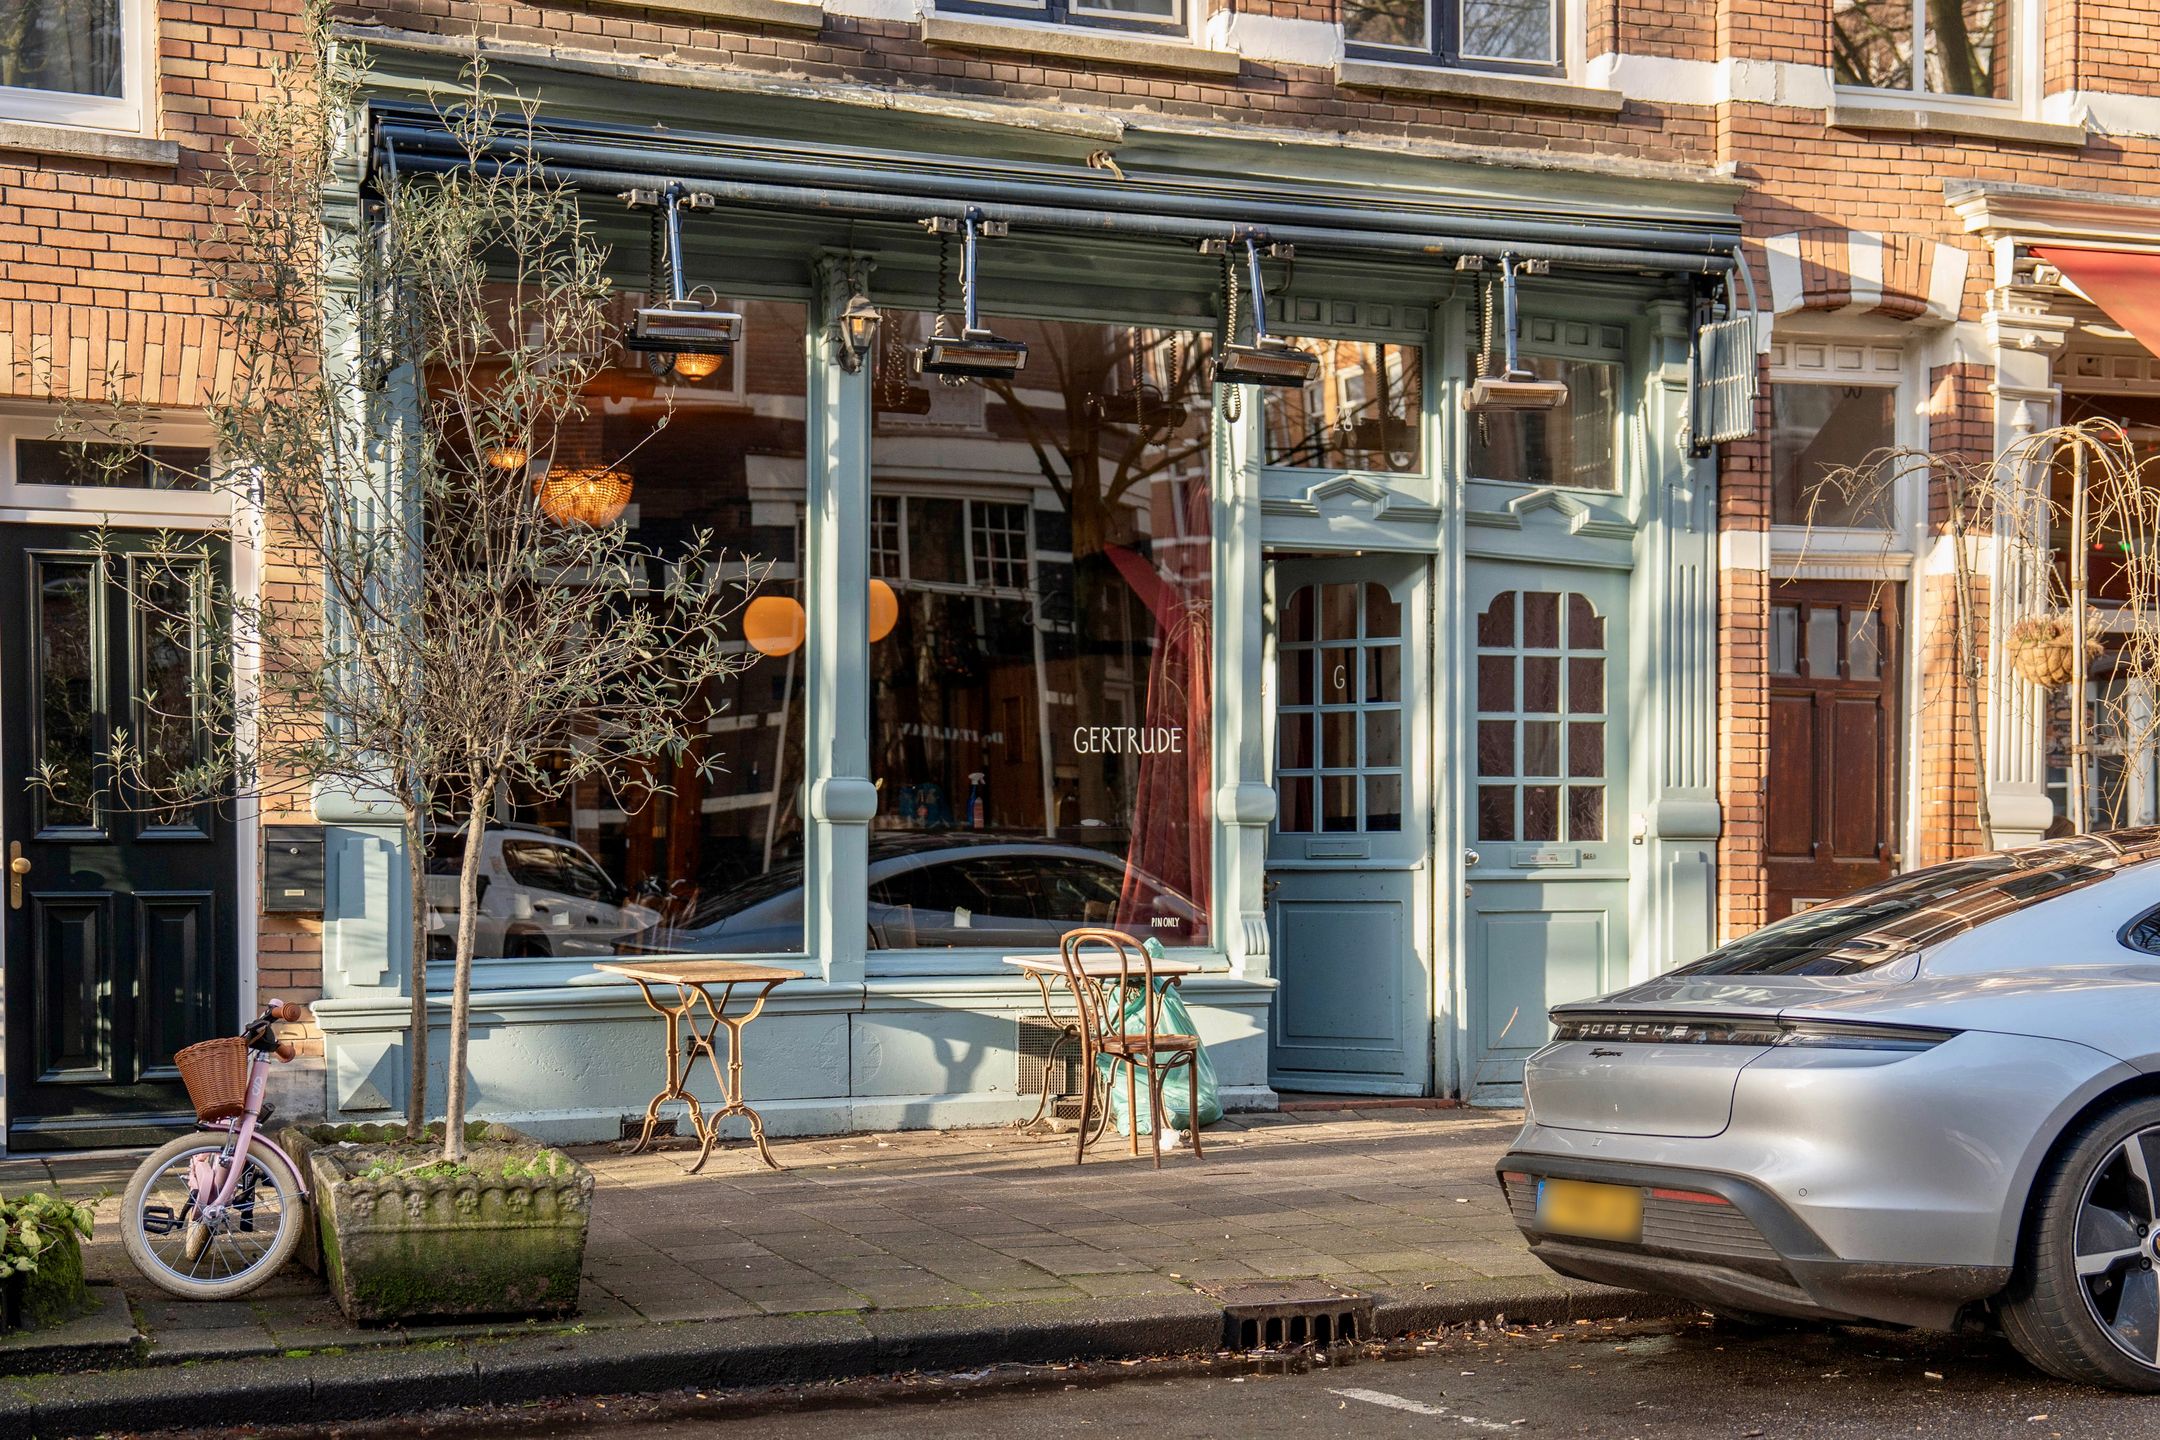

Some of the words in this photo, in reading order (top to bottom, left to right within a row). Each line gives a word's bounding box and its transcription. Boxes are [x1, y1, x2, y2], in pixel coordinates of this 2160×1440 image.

[1333, 405, 1353, 432] 28
[1333, 664, 1345, 690] G
[1073, 726, 1183, 755] GERTRUDE
[1151, 916, 1163, 928] PIN
[1163, 916, 1180, 928] ONLY
[1579, 1023, 1689, 1038] PORSCHE
